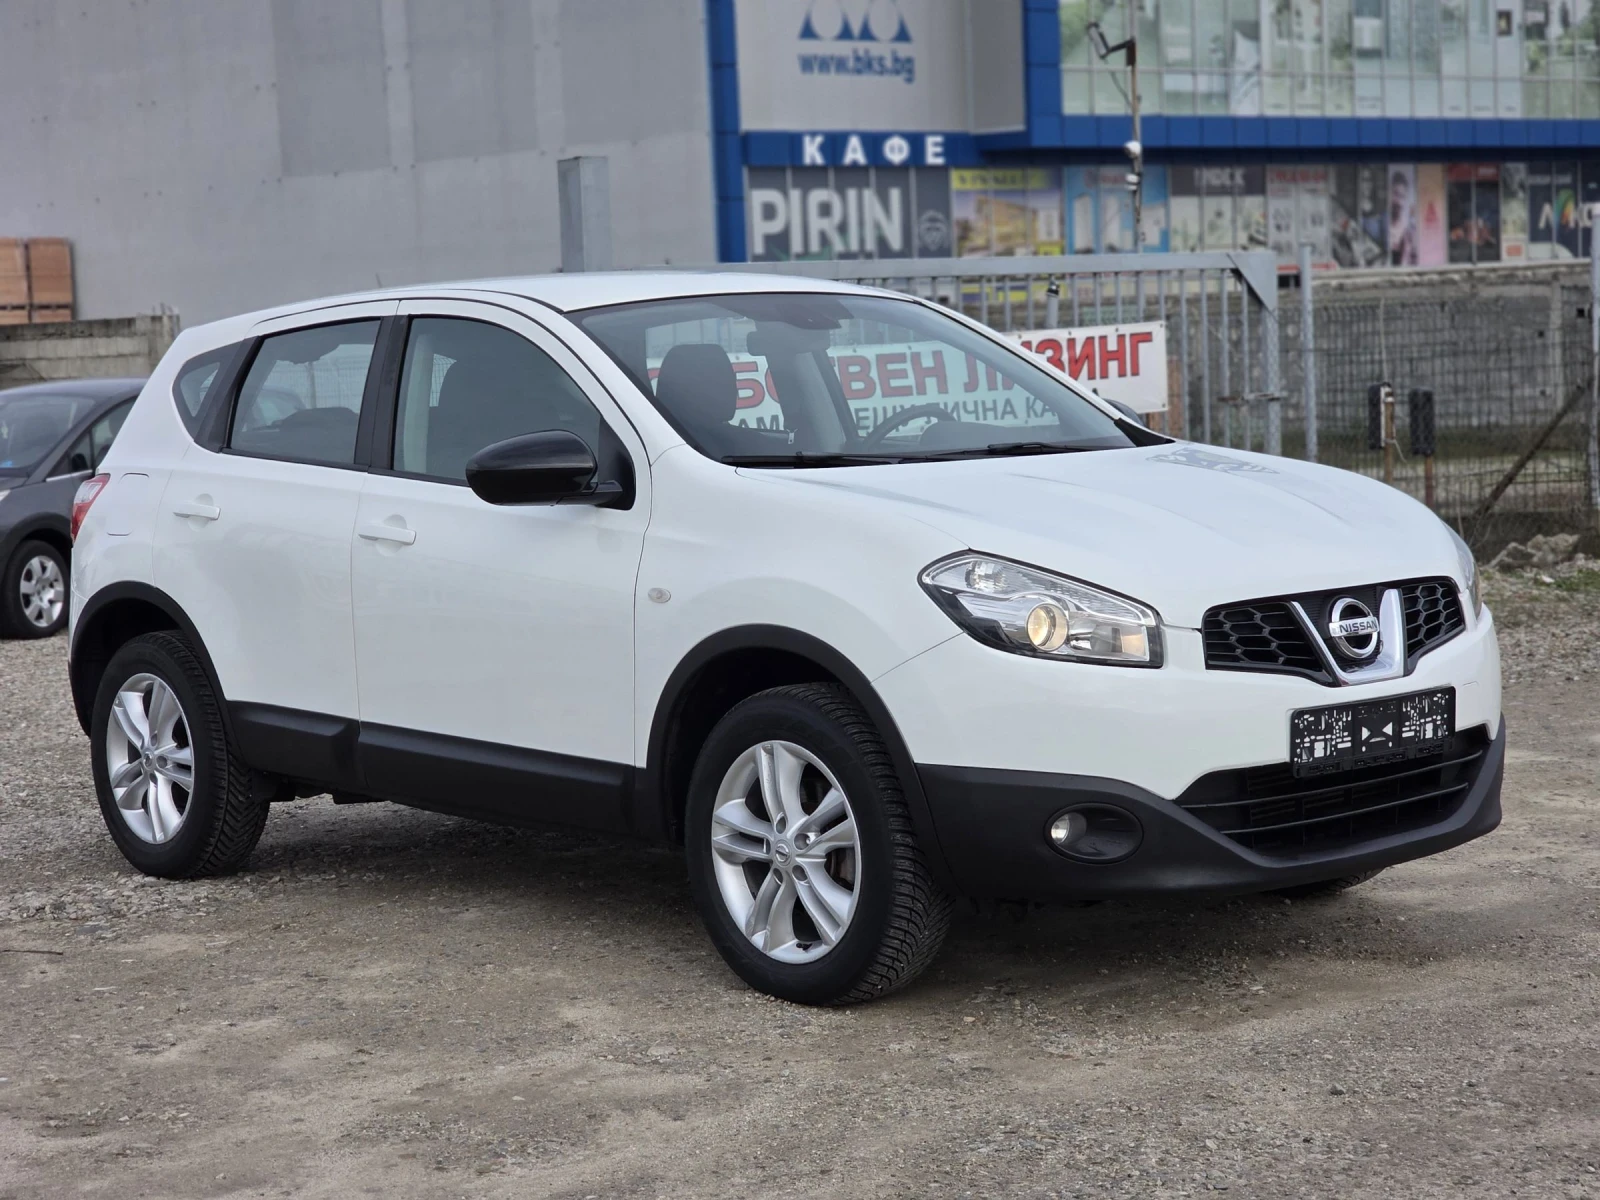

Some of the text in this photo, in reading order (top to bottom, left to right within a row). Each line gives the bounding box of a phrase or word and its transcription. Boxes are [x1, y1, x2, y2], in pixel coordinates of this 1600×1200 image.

[797, 50, 915, 83] www.bks.bg
[803, 135, 945, 165] КАФЕ
[751, 187, 903, 255] PIRIN
[1339, 619, 1378, 633] NISSAN
